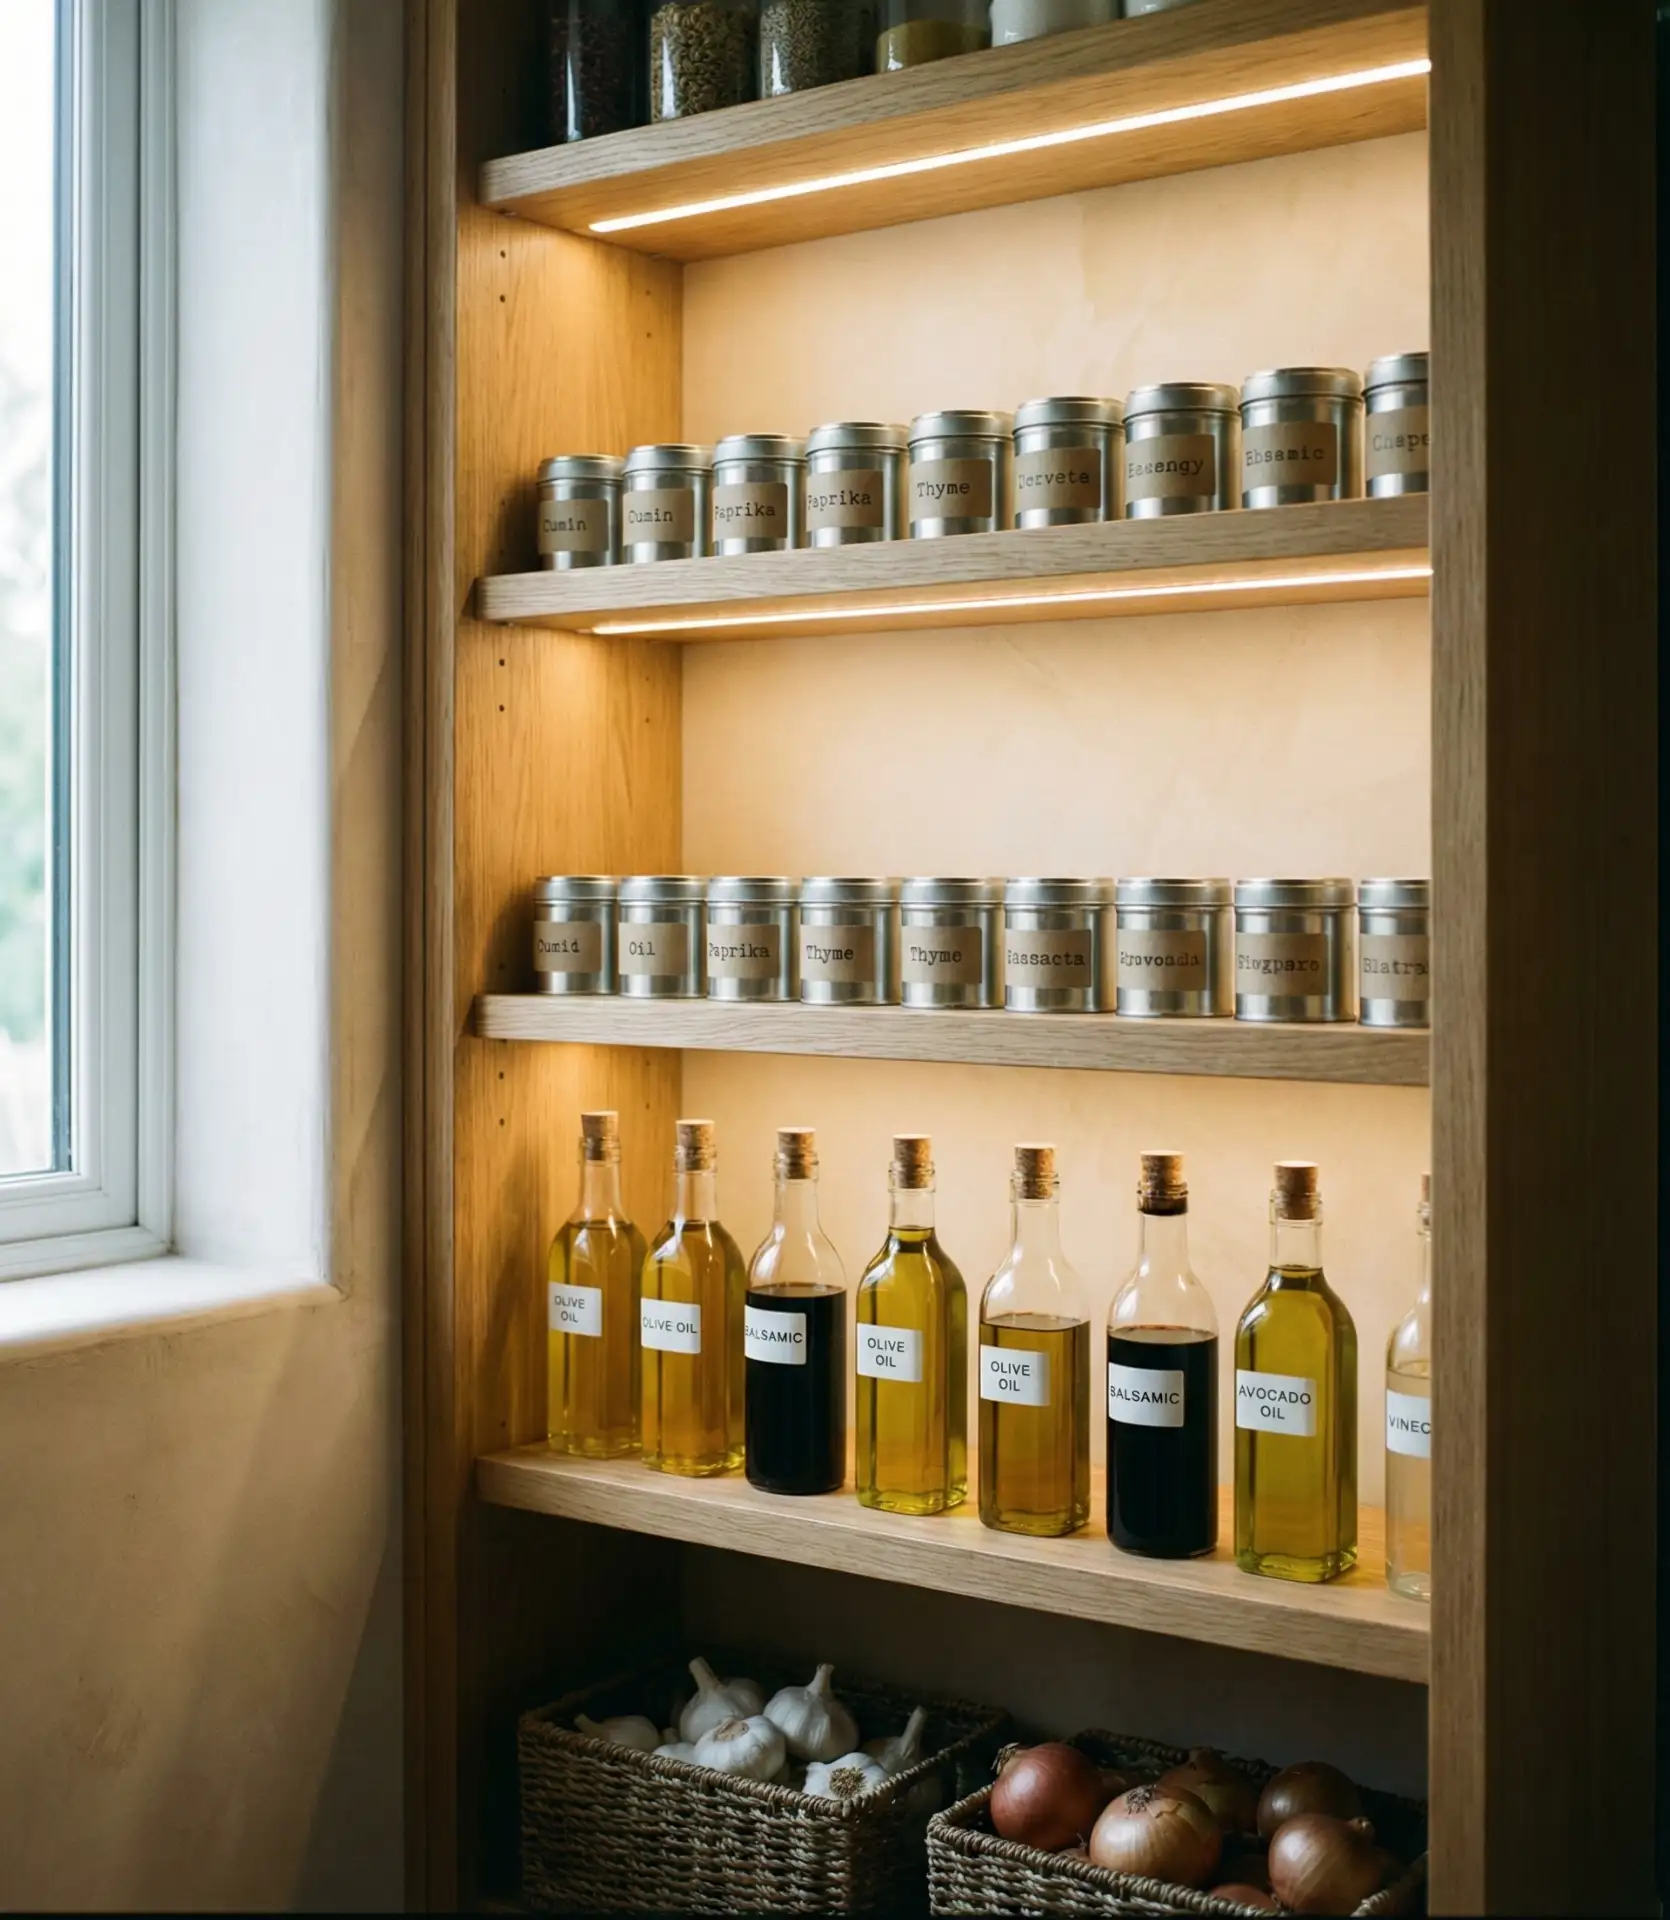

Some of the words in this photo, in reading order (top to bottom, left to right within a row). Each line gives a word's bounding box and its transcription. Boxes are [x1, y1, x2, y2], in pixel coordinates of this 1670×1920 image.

[917, 481, 970, 500] Thyme
[628, 508, 674, 524] Cumin
[543, 517, 587, 532] Cumin
[629, 941, 656, 956] Oil
[806, 945, 854, 964] Thyme
[910, 946, 962, 965] Thyme
[554, 1295, 585, 1309] OLIVE
[561, 1311, 578, 1323] OIL
[642, 1316, 672, 1332] OLIVE
[677, 1321, 698, 1334] OIL
[867, 1337, 905, 1353] OLIVE
[875, 1355, 896, 1368] OIL
[990, 1361, 1030, 1377] OLIVE
[998, 1378, 1020, 1392] OIL
[1110, 1385, 1180, 1405] BALSAMIC
[1238, 1384, 1311, 1405] AVOCADO
[1260, 1405, 1285, 1420] OIL
